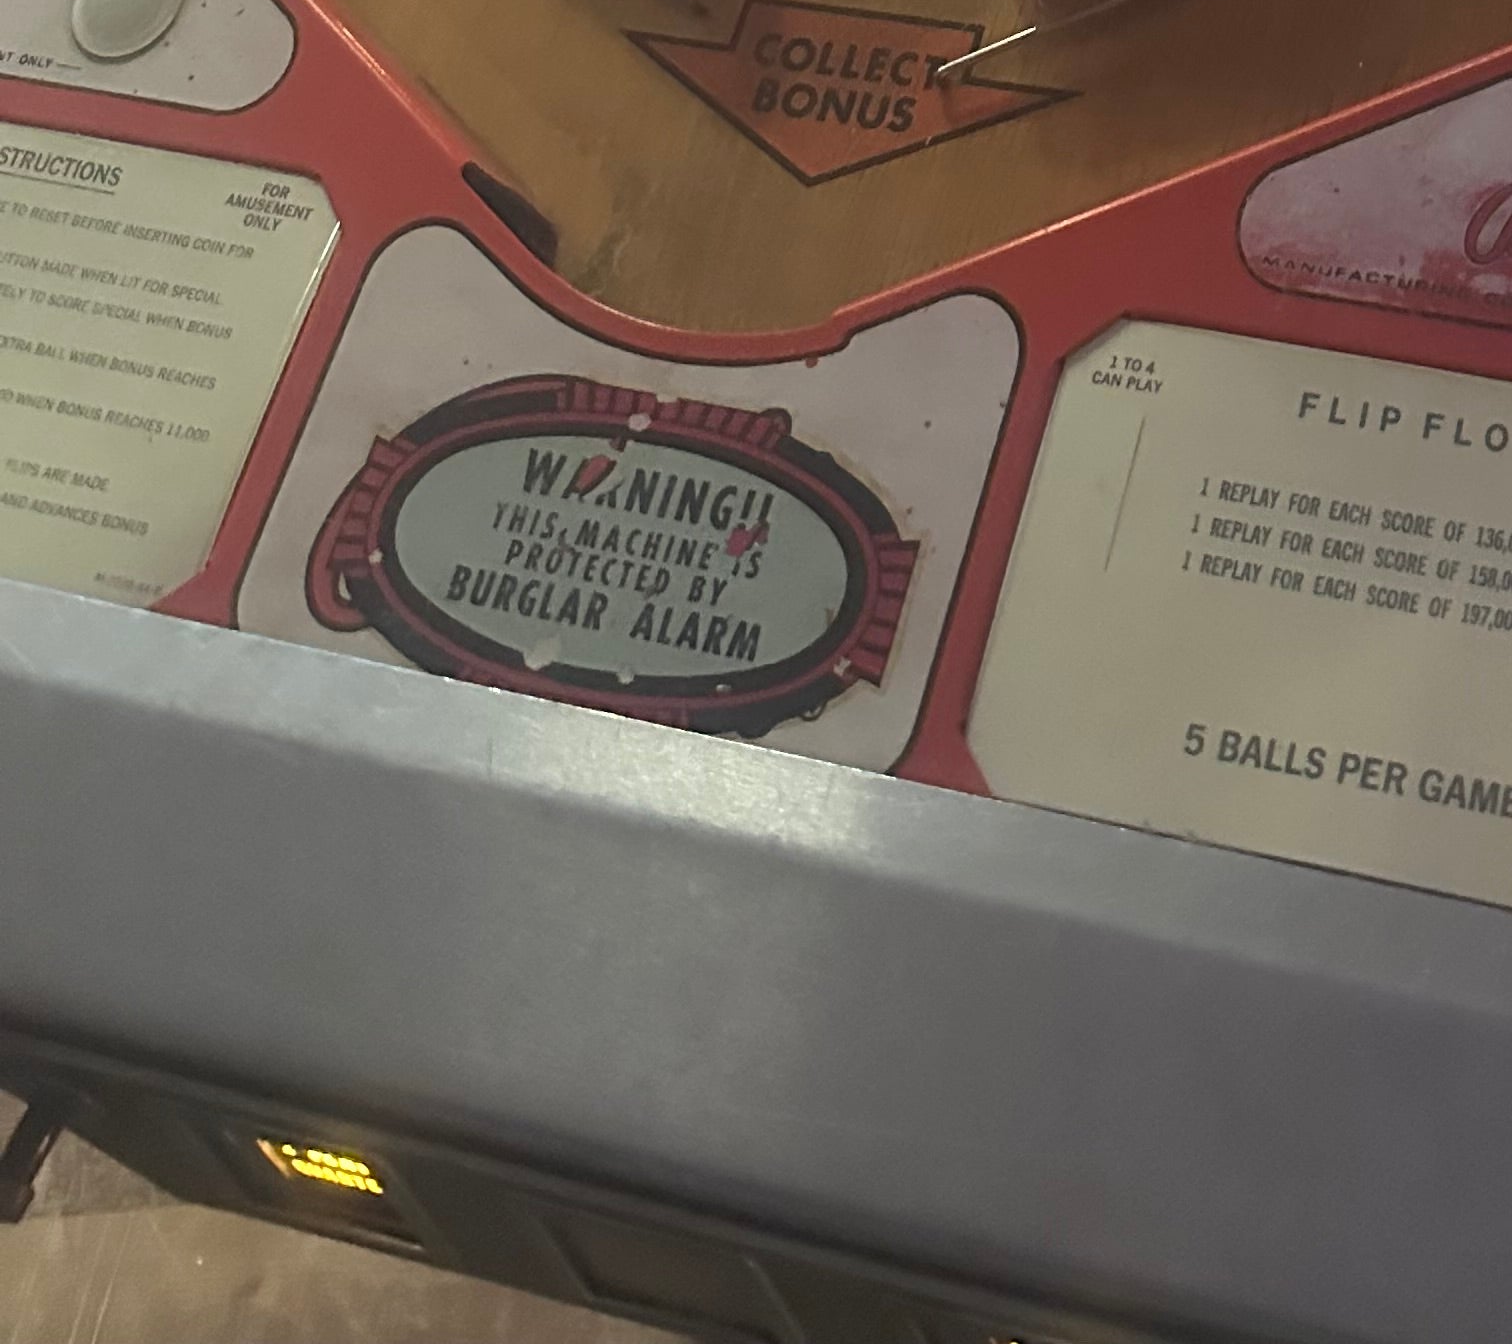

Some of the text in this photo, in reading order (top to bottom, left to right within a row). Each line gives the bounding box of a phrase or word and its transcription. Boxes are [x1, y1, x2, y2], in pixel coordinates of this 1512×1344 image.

[18, 53, 55, 69] ONLY
[752, 31, 954, 92] COLLECT
[751, 77, 920, 134] BONUS
[224, 192, 314, 221] AMUSEMENT
[261, 182, 291, 199] FOR
[71, 213, 122, 236] BEFORE
[123, 223, 190, 249] INSERTING
[193, 237, 225, 256] COIN
[227, 244, 255, 259] FOR
[242, 213, 283, 232] ONLY
[80, 266, 118, 286] WHEN
[120, 272, 140, 288] LIT
[143, 278, 168, 296] FOR
[91, 300, 141, 325] SPECIAL
[146, 312, 184, 331] WHEN
[186, 320, 233, 340] BONUS
[69, 346, 108, 369] WHEN
[109, 355, 154, 378] BONUS
[156, 367, 217, 391] REACHES
[1091, 370, 1163, 394] CAN PLAY
[1109, 355, 1156, 375] 1 TO 4
[16, 391, 55, 412] WHEN
[56, 400, 103, 422] BONUS
[103, 409, 164, 435] REACHES
[165, 422, 210, 443] 11,000
[1297, 391, 1402, 432] FLIP
[41, 466, 71, 485] ARE
[69, 471, 111, 493] MADE
[101, 512, 150, 537] BONUS
[1199, 476, 1210, 497] 1
[1218, 479, 1281, 510] REPLAY
[1288, 492, 1320, 518] FOR
[1327, 500, 1372, 527] EACH
[1380, 509, 1435, 539] SCORE
[1443, 519, 1468, 543] OF
[492, 502, 559, 540] THIS
[574, 517, 720, 572] MACHINE
[1190, 513, 1200, 534] 1
[1209, 516, 1272, 549] REPLAY
[1279, 529, 1314, 556] FOR
[1320, 538, 1365, 566] EACH
[1372, 546, 1427, 577] SCORE
[1436, 557, 1460, 581] OF
[505, 539, 727, 607] PROTECTED BY
[1181, 549, 1192, 571] 1
[1200, 553, 1263, 585] REPLAY
[1269, 566, 1305, 593] FOR
[1312, 574, 1356, 602] EACH
[1365, 584, 1419, 614] SCORE
[1427, 595, 1453, 619] OF
[447, 564, 763, 663] BURGLAR ALARM
[1183, 722, 1207, 757] 5
[1216, 729, 1328, 781] BALLS
[1337, 752, 1409, 797] PER
